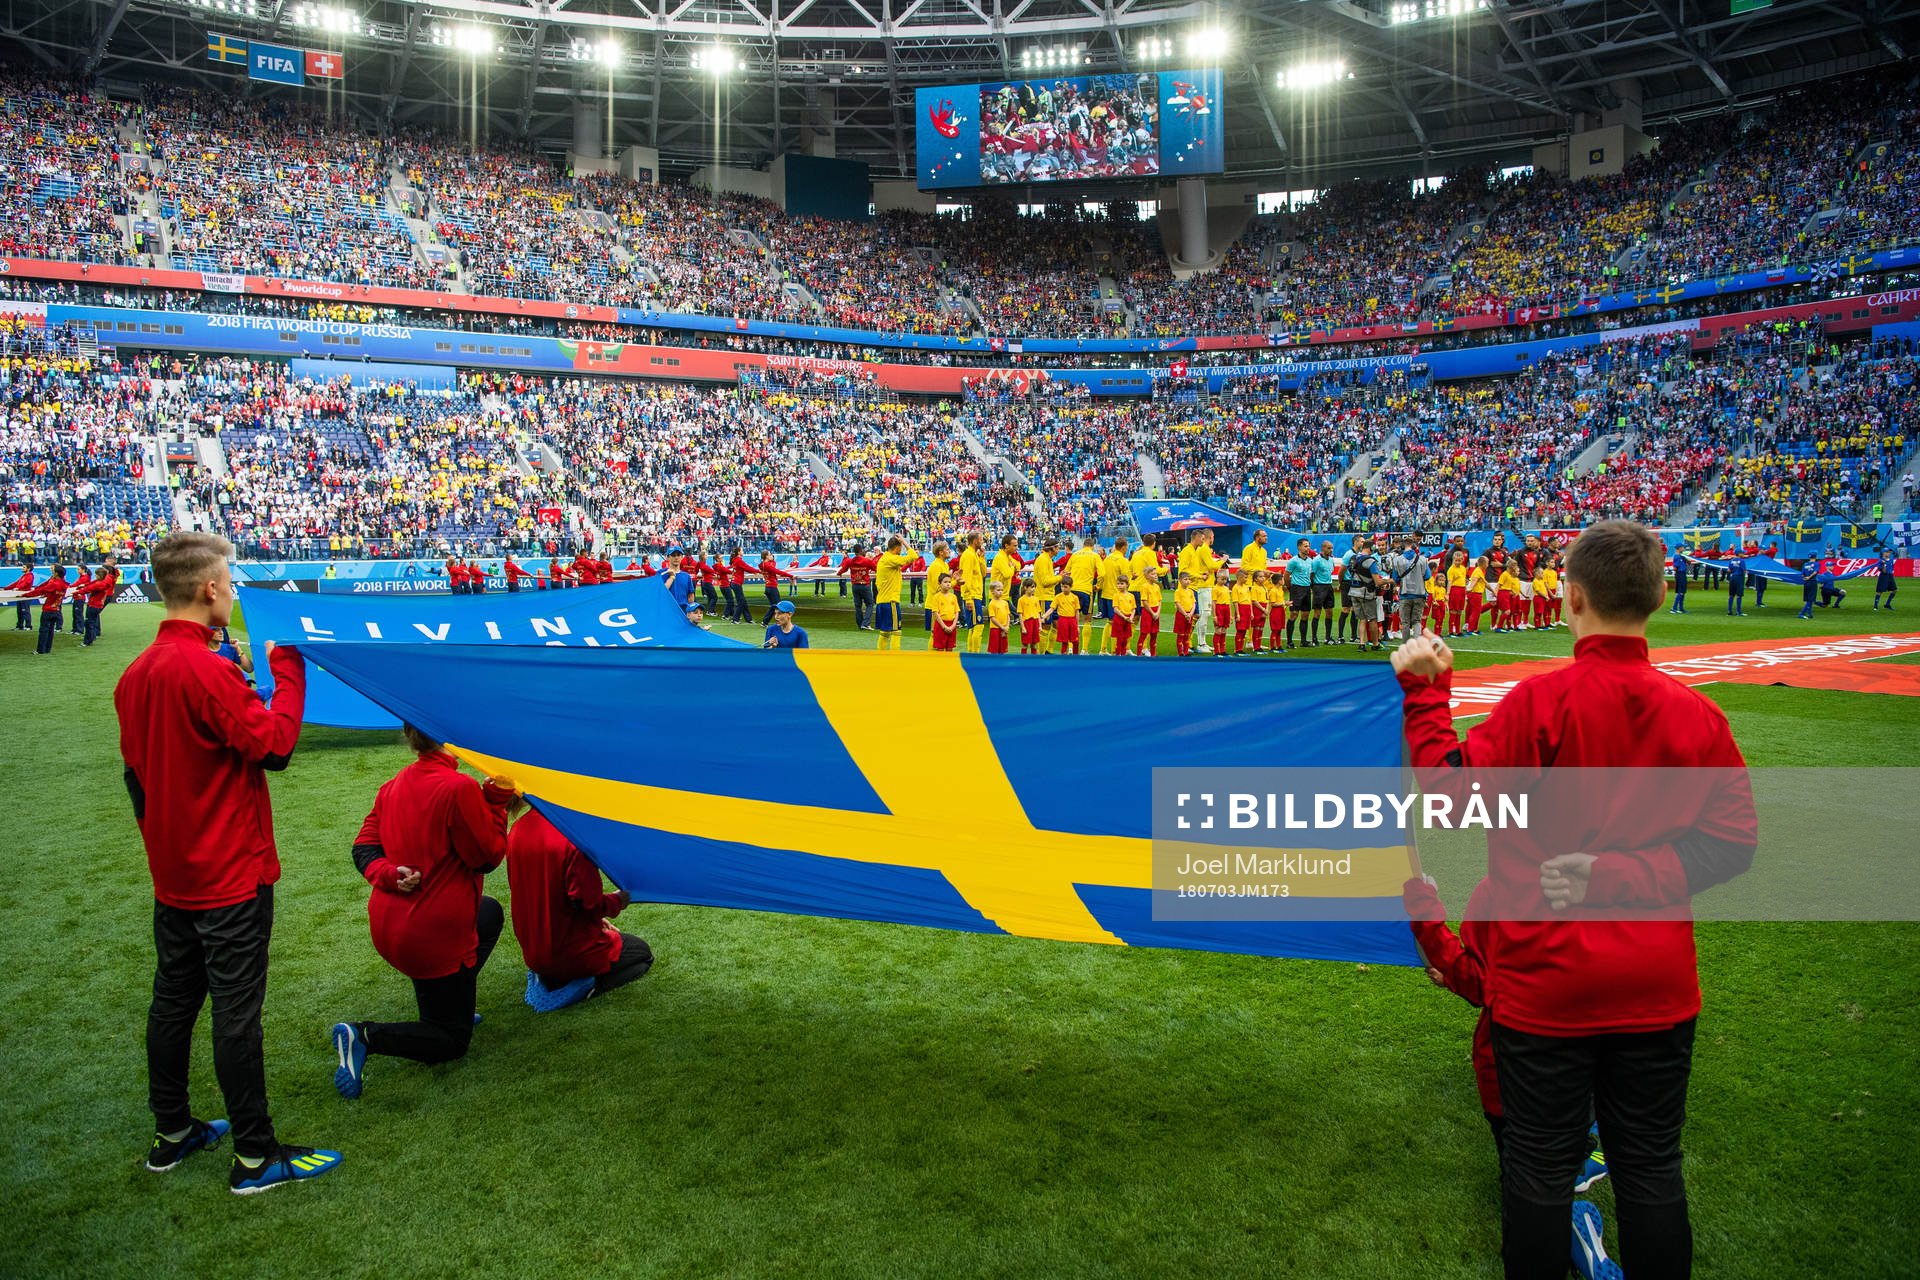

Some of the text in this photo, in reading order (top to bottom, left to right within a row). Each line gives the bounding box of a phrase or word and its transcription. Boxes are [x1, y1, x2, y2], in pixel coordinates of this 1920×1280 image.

[257, 55, 296, 74] FIFA
[284, 282, 343, 298] #worldcup
[207, 316, 412, 339] 2018 FIFA WORLD CUP RUSSIA
[766, 355, 863, 371] SAINT PETERSBURG
[1311, 361, 1333, 371] FIFA
[1335, 360, 1359, 369] 2018
[353, 581, 383, 593] 2018
[385, 580, 412, 592] FIFA
[414, 579, 451, 591] WORL
[115, 595, 149, 603] adidas
[300, 607, 638, 641] LIVING
